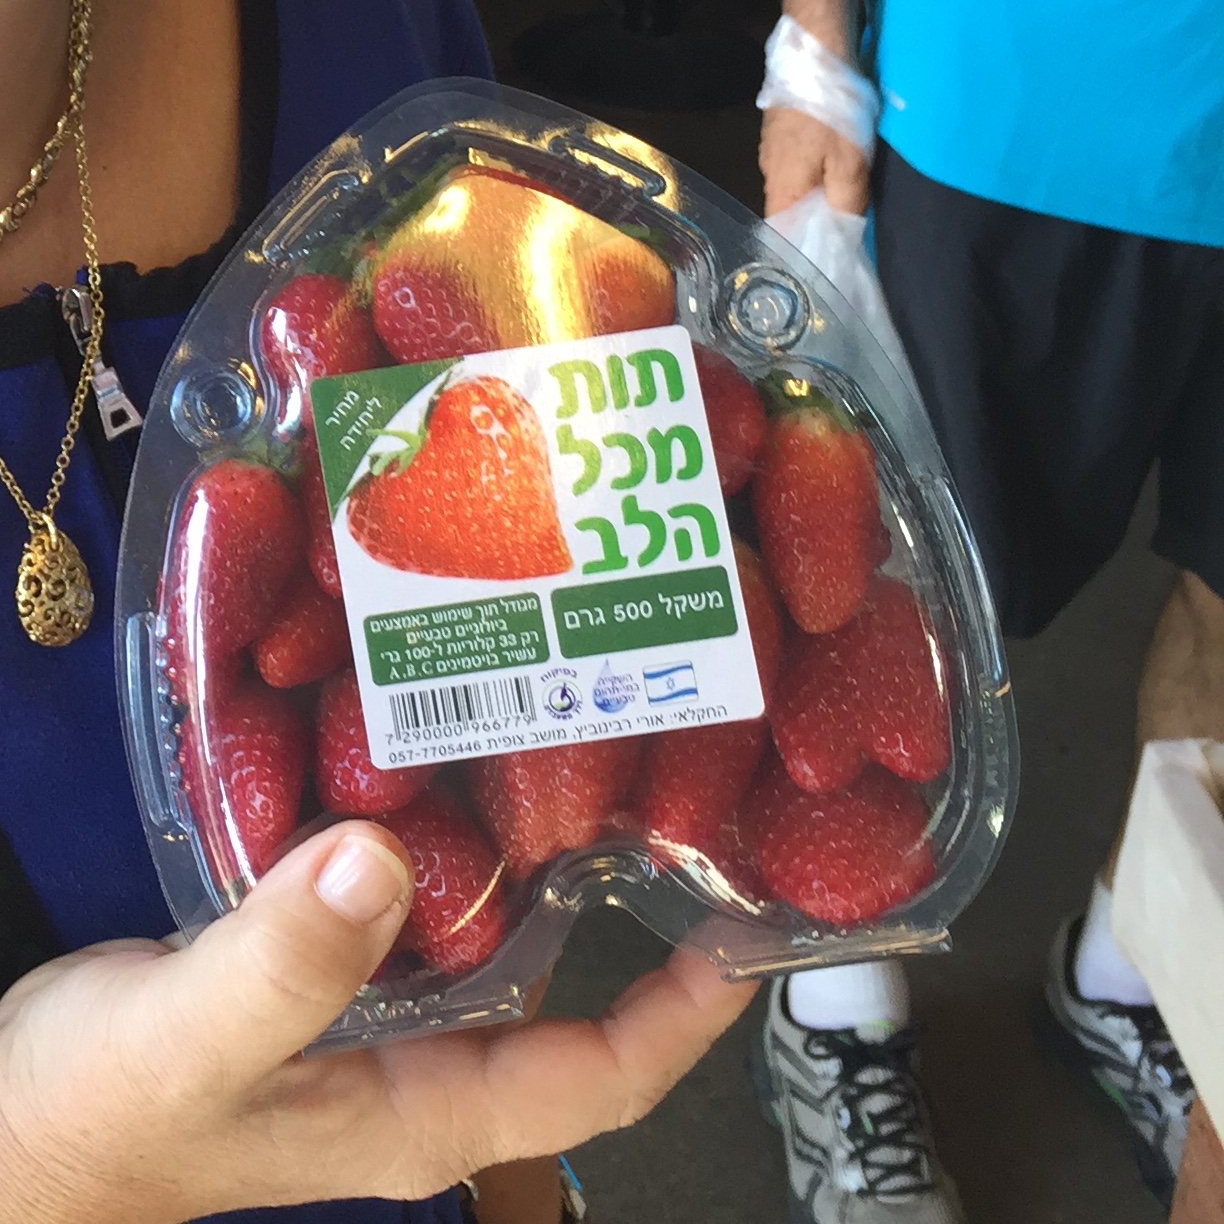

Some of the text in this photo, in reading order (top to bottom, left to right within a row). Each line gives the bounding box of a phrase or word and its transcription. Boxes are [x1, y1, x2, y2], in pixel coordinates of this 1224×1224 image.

[547, 347, 686, 419] תות
[325, 390, 360, 426] מחיר
[339, 396, 383, 452] ליחידה
[556, 422, 705, 497] מכל
[574, 494, 723, 576] הלב
[369, 597, 539, 633] מגודל תוך שימוש באמצעים
[563, 590, 724, 630] משקל 500 גרם
[406, 626, 452, 645] טבעיים
[446, 636, 496, 656] קלוריות
[499, 633, 518, 648] 33
[520, 630, 540, 649] רק
[435, 652, 500, 674] בויטמינים
[502, 647, 537, 664] עשיר
[636, 713, 665, 727] אורי
[486, 734, 525, 750] צופית
[530, 727, 567, 744] מושב
[388, 739, 482, 763] 057-7705446
